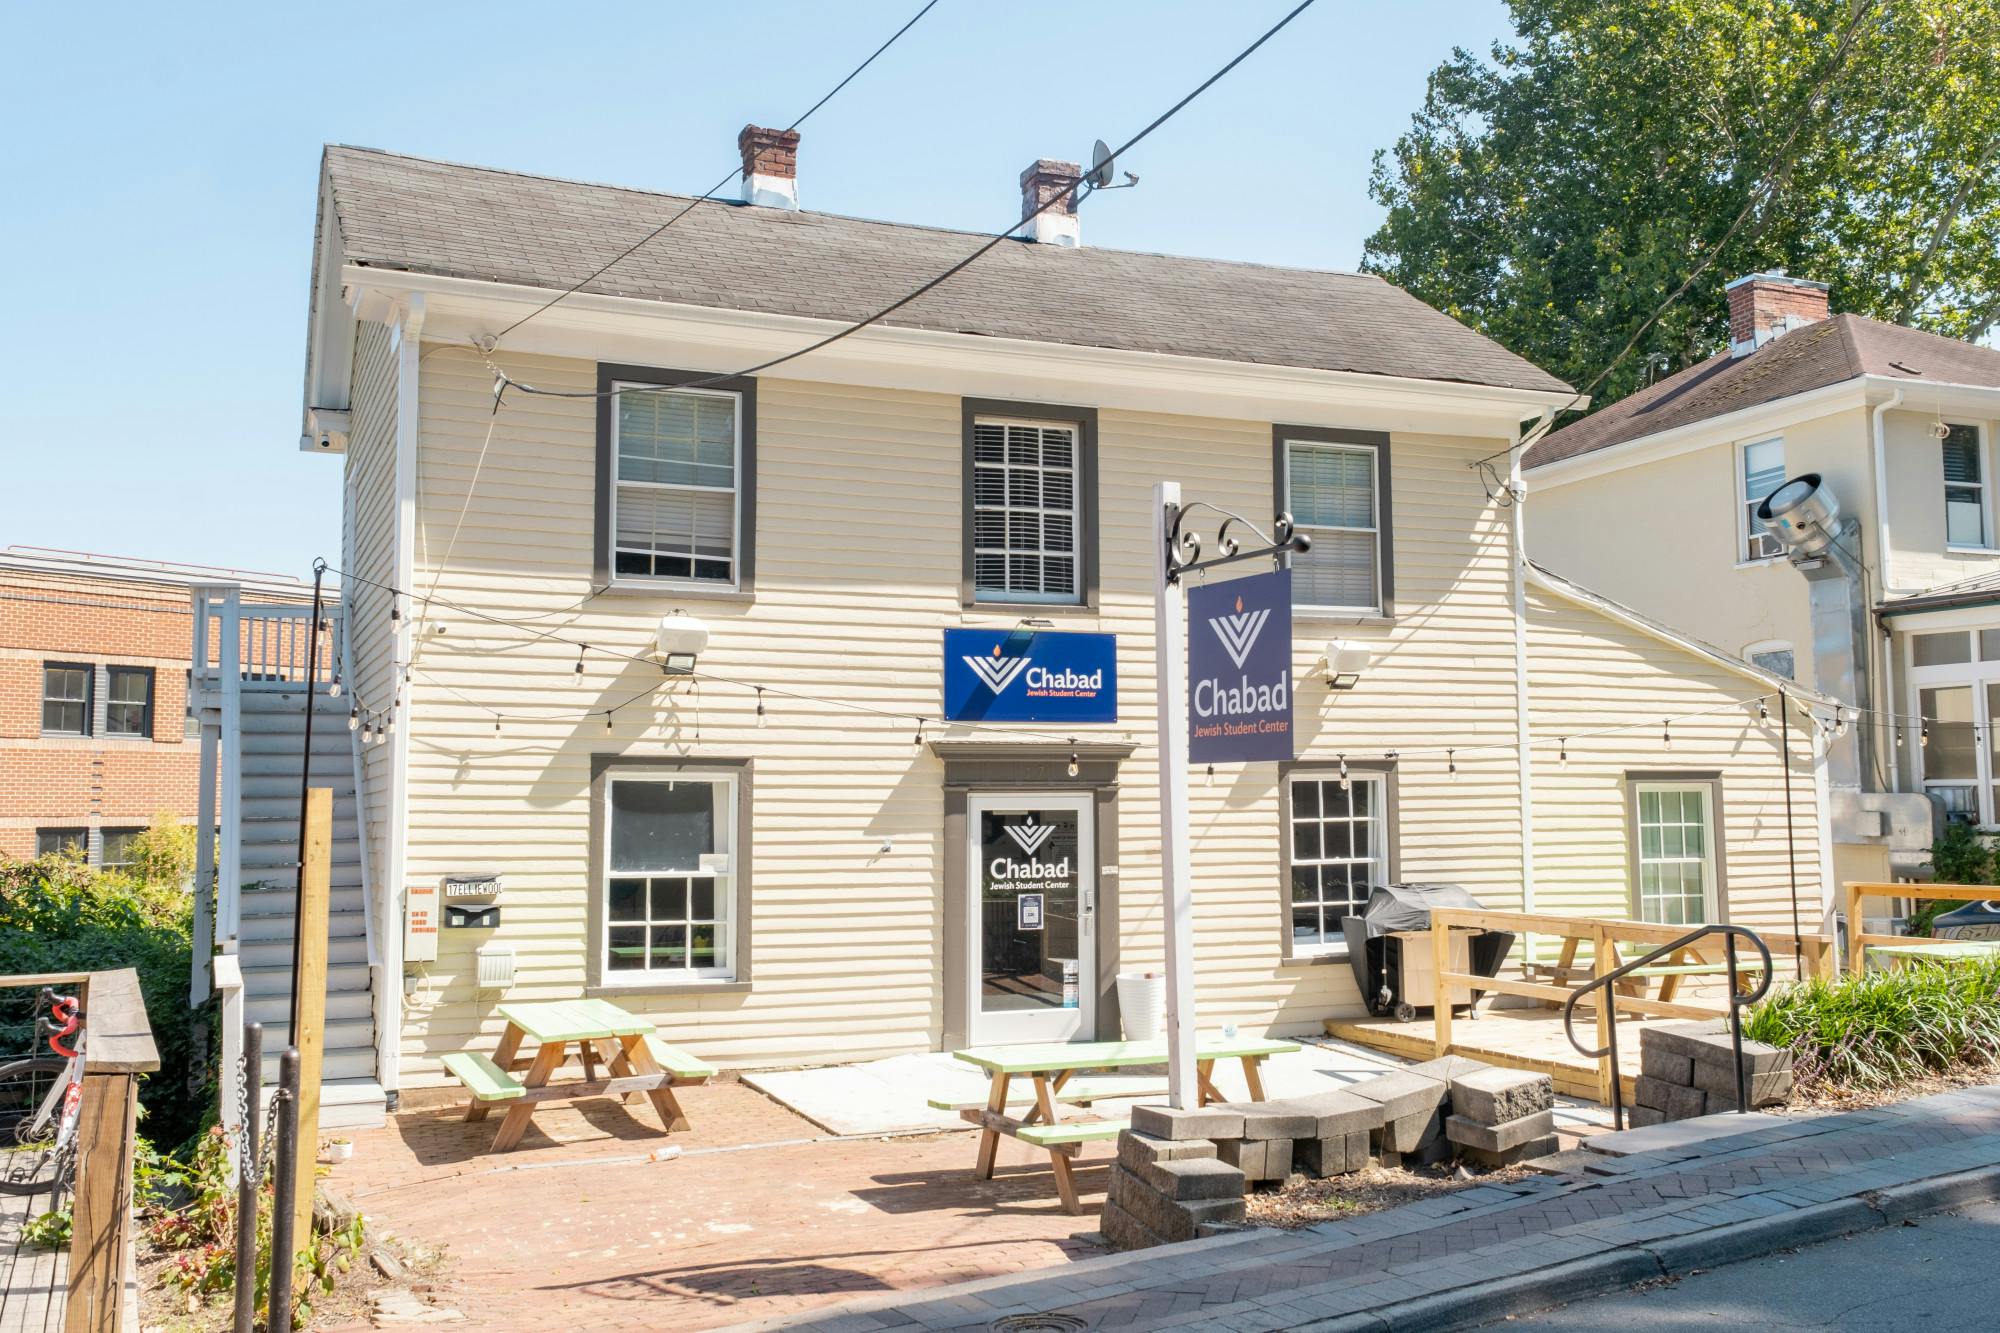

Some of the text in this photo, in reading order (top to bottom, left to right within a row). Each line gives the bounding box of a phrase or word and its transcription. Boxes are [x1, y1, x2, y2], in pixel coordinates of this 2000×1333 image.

[1025, 667, 1102, 689] Chabad
[1026, 689, 1097, 698] Jewish Student Center
[1194, 670, 1287, 717] Chabad
[1194, 719, 1288, 738] Jewish Student Center
[990, 856, 1069, 879] Chabad
[989, 880, 1070, 891] Jewish Student Center
